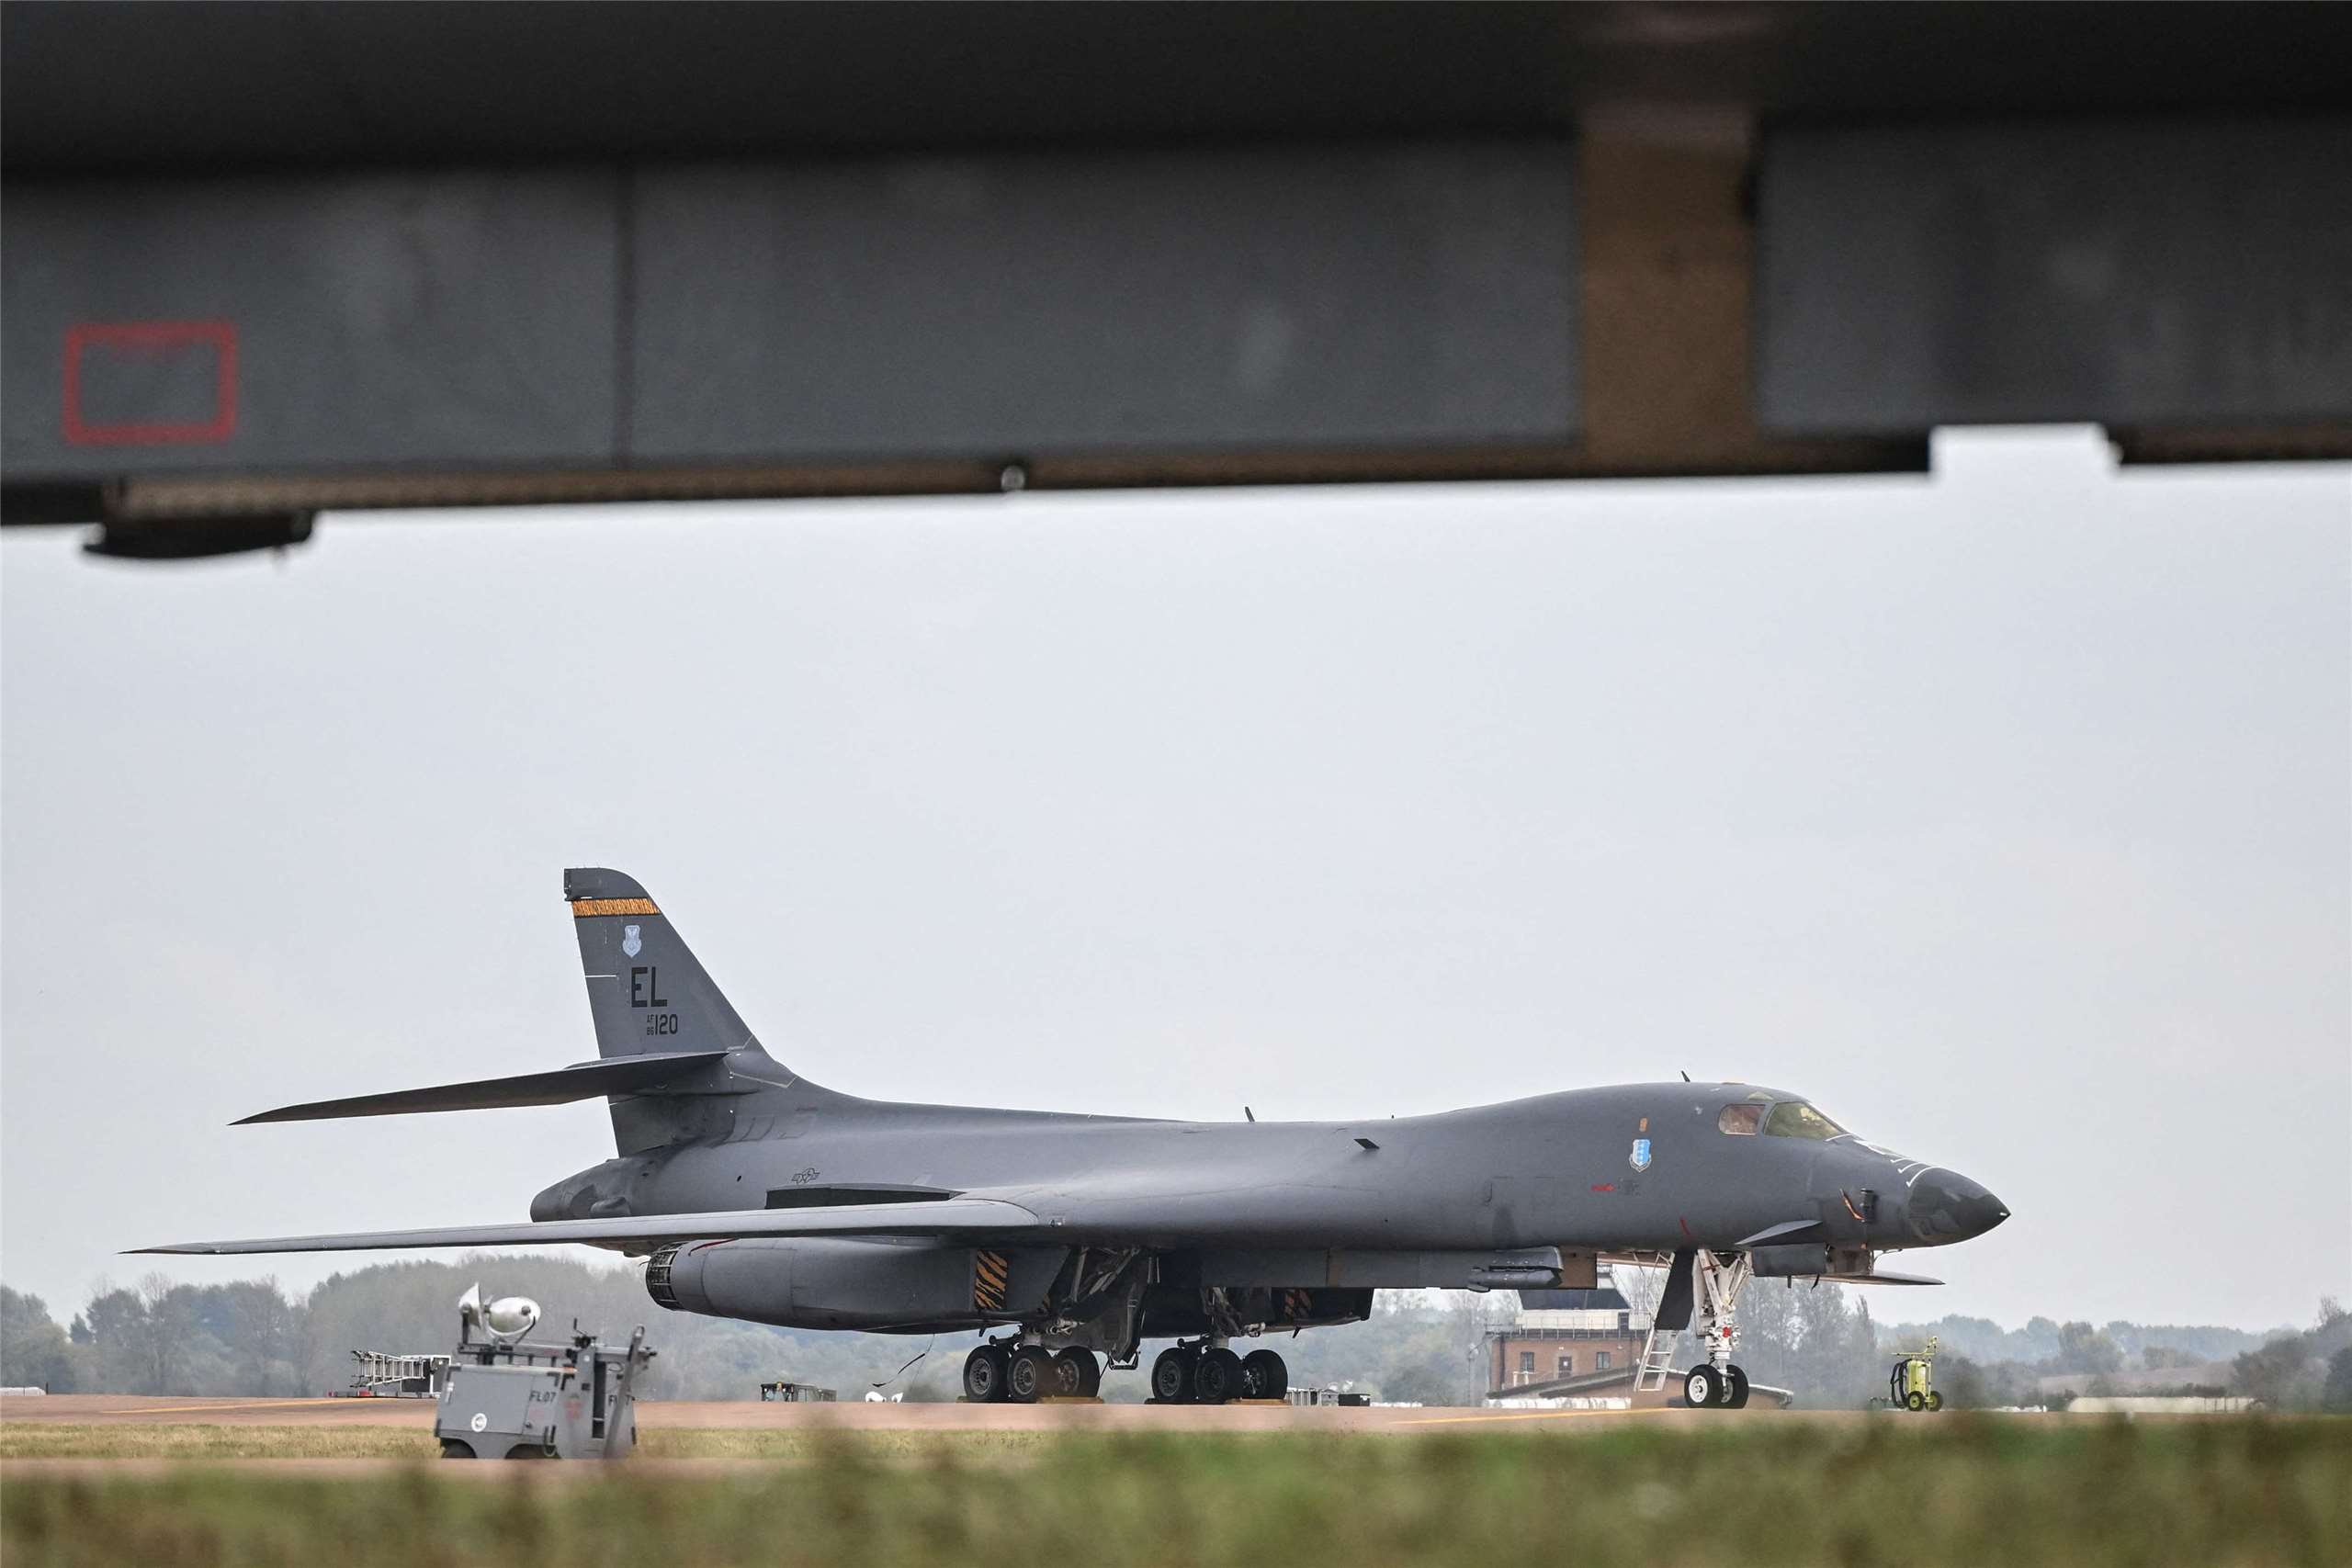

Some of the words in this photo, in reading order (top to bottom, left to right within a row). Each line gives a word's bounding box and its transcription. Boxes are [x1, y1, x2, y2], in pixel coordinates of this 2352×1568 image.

[631, 966, 667, 1008] EL
[655, 1014, 678, 1035] 120
[529, 1391, 557, 1403] FL07
